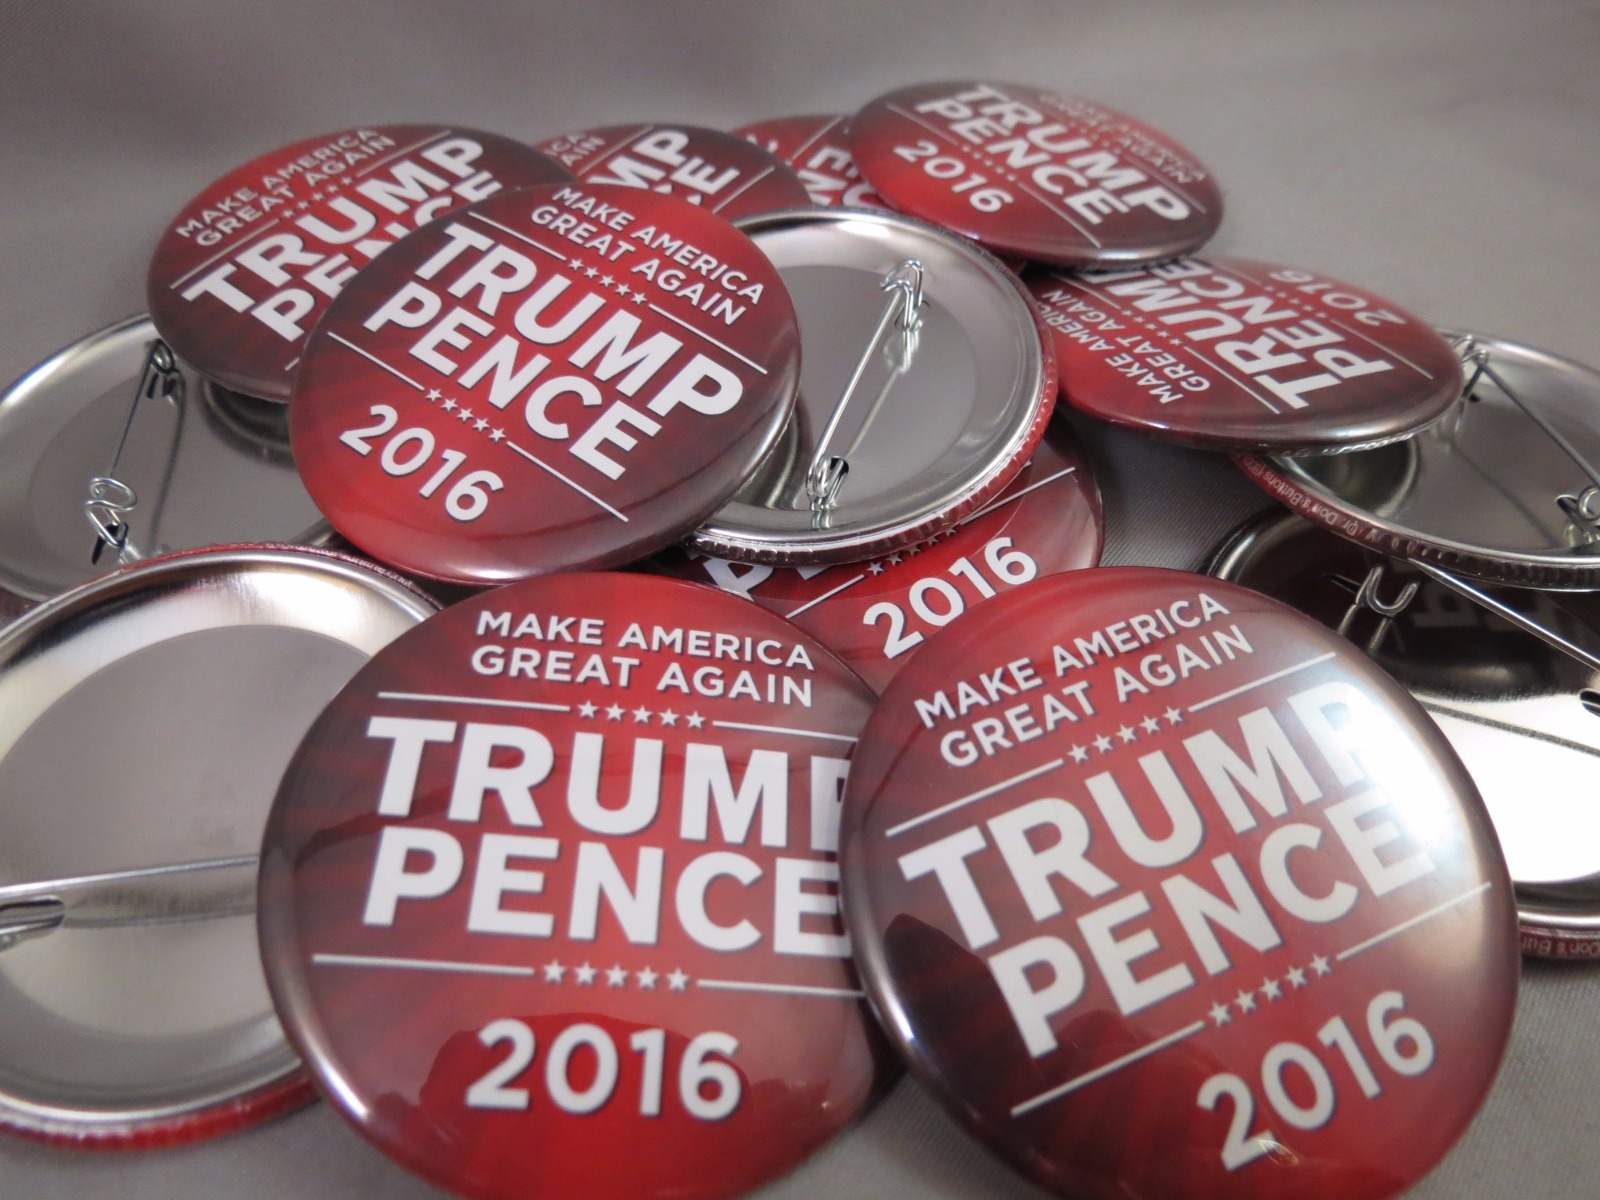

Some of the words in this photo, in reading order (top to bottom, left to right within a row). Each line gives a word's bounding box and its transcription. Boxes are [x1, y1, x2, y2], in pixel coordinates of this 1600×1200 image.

[176, 186, 259, 239] MAKE
[263, 130, 379, 189] AMERICA
[195, 187, 297, 247] GREAT
[304, 136, 396, 187] AGAIN
[893, 140, 1014, 213] 2016
[915, 98, 1131, 225] PENCE
[955, 85, 1190, 221] TRUMP
[181, 138, 484, 314] TRUMP
[531, 205, 635, 262] GREAT
[631, 257, 746, 326] AGAIN
[551, 187, 635, 232] MAKE
[631, 226, 765, 305] AMERICA
[415, 223, 744, 417] TRUMP
[1042, 289, 1127, 331] AGAIN
[1152, 257, 1395, 379] PENCE
[1270, 269, 1407, 326] 2016
[363, 282, 663, 481] PENCE
[1104, 352, 1184, 404] MAKE
[1115, 335, 1211, 392] GREAT
[339, 404, 504, 522] 2016
[475, 610, 605, 646] MAKE
[618, 621, 815, 670] AMERICA
[862, 536, 1038, 659] 2016
[470, 644, 641, 688] GREAT
[656, 668, 813, 708] AGAIN
[913, 656, 1044, 729] MAKE
[1053, 592, 1231, 677] AMERICA
[940, 679, 1097, 768] GREAT
[1115, 624, 1255, 701] AGAIN
[363, 825, 853, 958] PENCE
[988, 785, 1437, 1059] PENCE
[465, 1017, 743, 1122] 2016
[1196, 989, 1436, 1173] 2016
